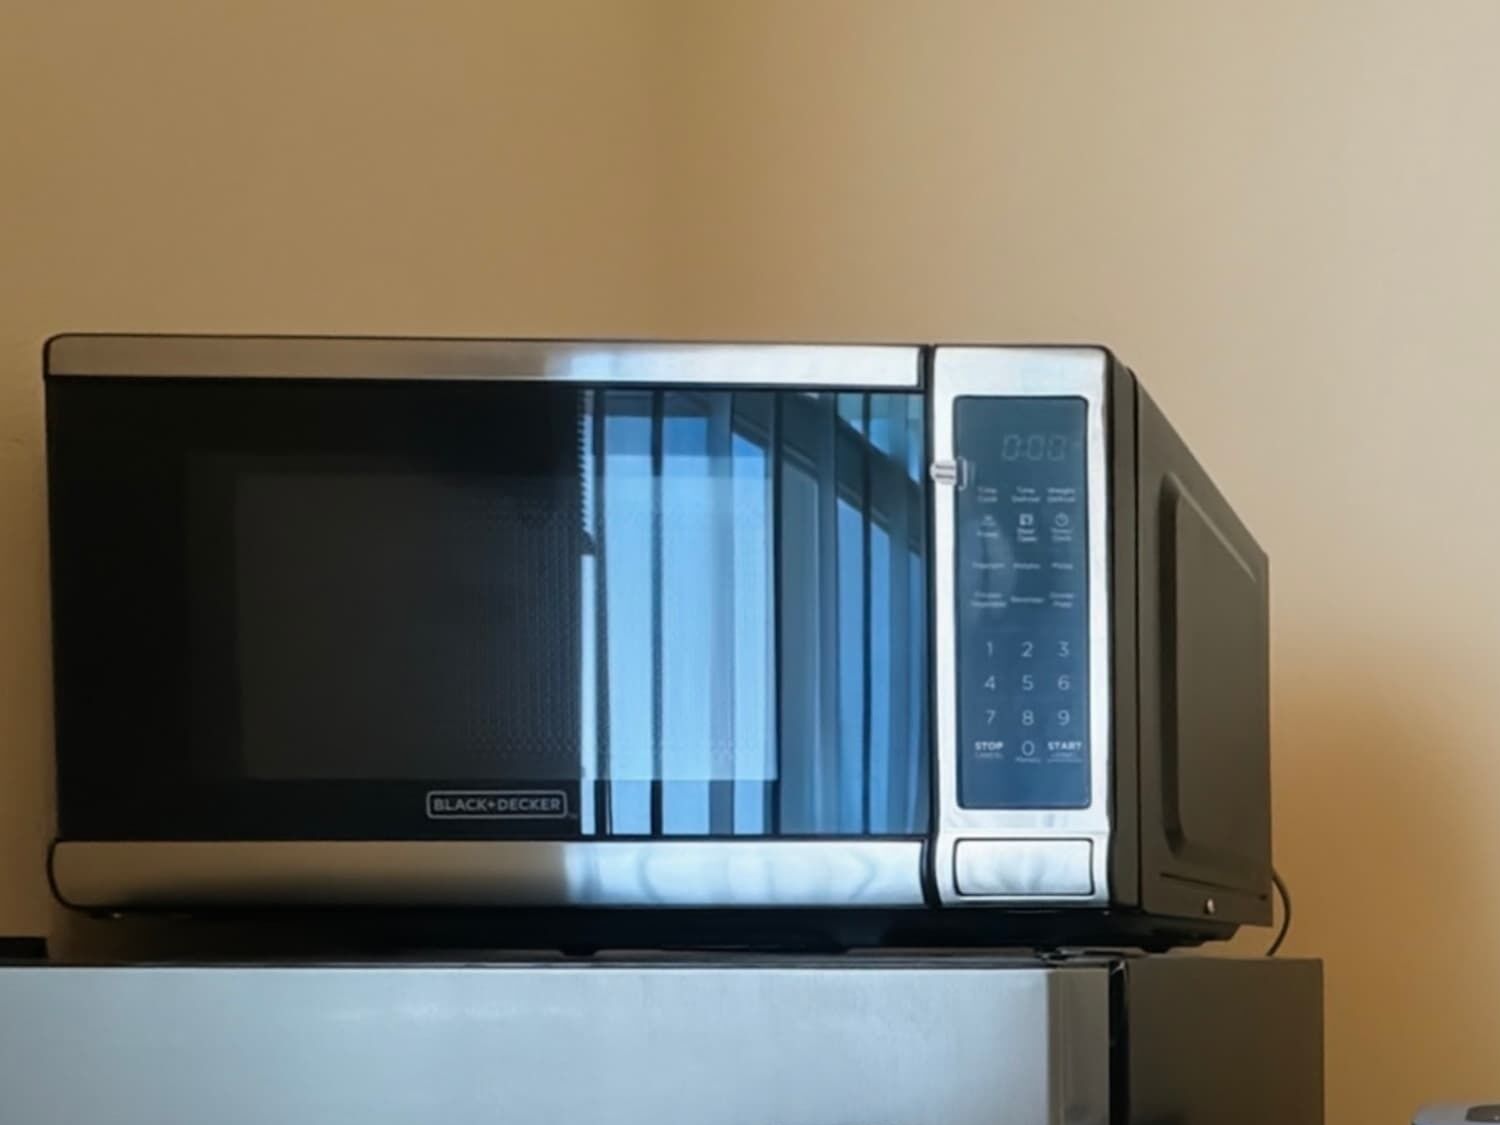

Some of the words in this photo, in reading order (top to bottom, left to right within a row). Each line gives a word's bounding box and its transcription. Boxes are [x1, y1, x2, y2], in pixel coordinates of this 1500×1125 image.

[986, 641, 993, 656] 1
[1020, 641, 1034, 658] 2
[1058, 641, 1070, 657] 3
[984, 675, 996, 690] 4
[1021, 675, 1034, 691] 5
[1057, 675, 1070, 691] 6
[985, 710, 996, 725] 7
[1021, 710, 1035, 726] 8
[1057, 710, 1070, 726] 9
[974, 741, 1004, 750] STOP
[1021, 740, 1035, 757] 0
[1048, 741, 1082, 750] START
